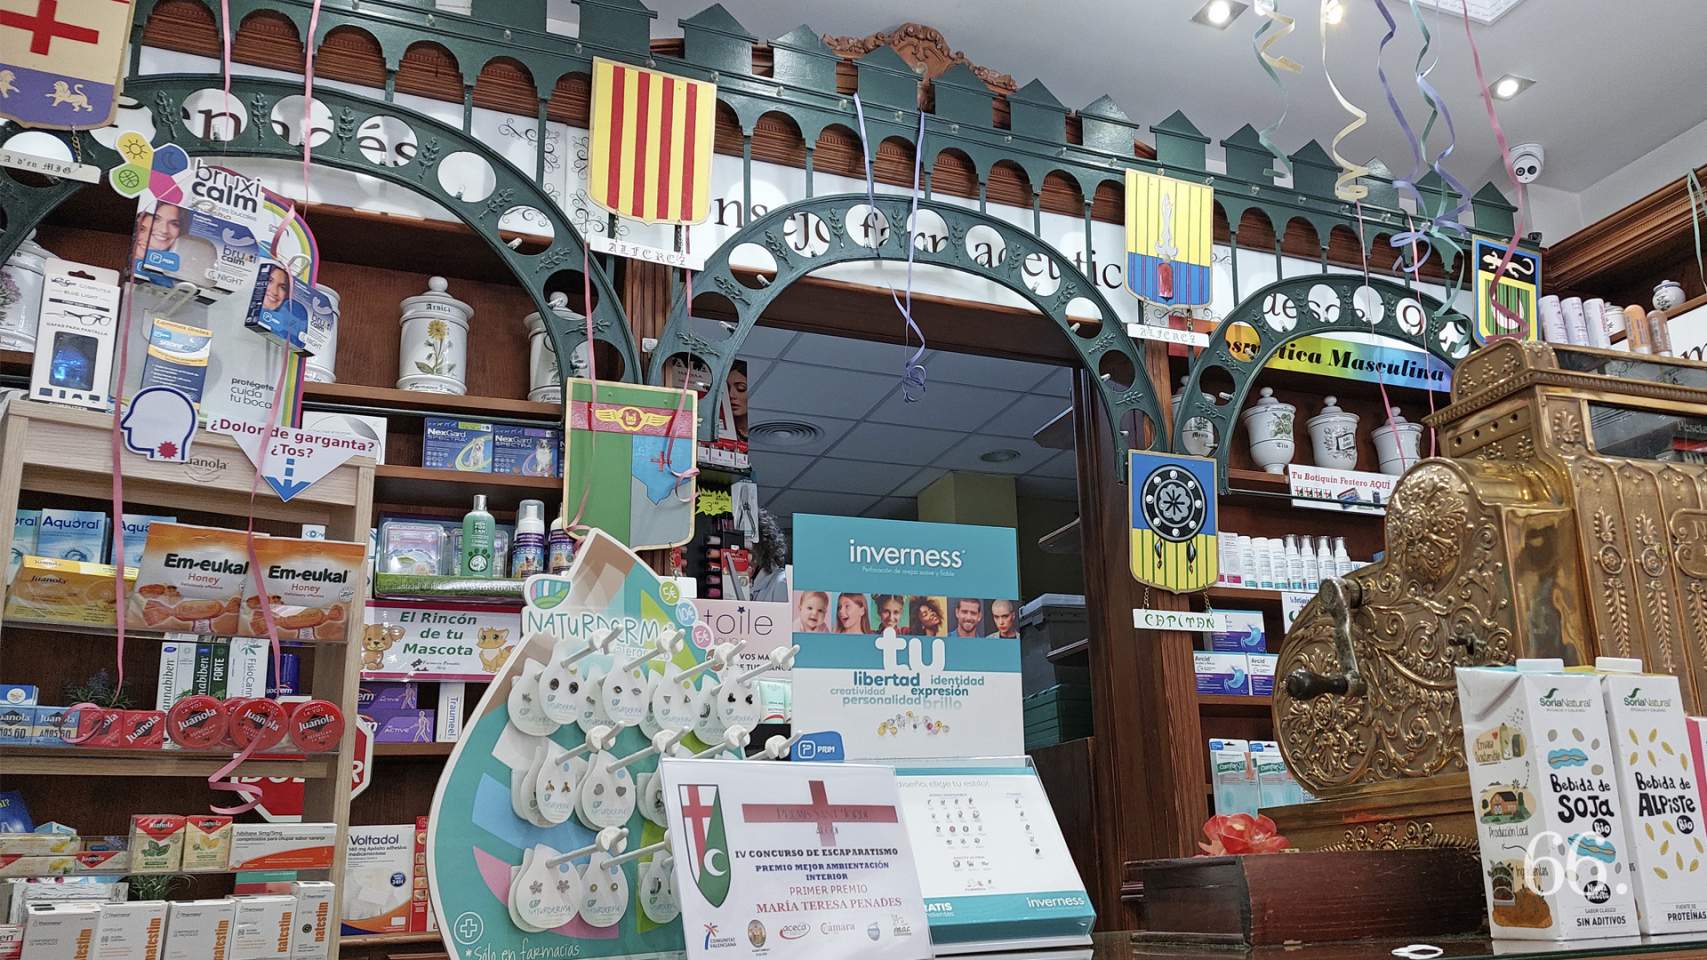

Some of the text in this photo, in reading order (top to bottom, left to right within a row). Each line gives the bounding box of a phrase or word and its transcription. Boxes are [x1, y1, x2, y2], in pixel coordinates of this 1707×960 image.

[195, 158, 262, 198] bruxi
[192, 181, 258, 213] calm
[217, 273, 245, 286] NIGHT
[1328, 350, 1444, 382] Masculina
[230, 386, 263, 399] cuida
[229, 394, 273, 410] tu boca
[270, 426, 290, 440] de
[294, 430, 375, 453] garganta?
[427, 427, 466, 438] NexGard
[270, 443, 314, 459] ¿Tos?
[185, 457, 229, 471] uanola
[43, 515, 100, 530] Aquoral
[849, 539, 963, 569] inverness
[164, 552, 250, 575] Em-eukal
[188, 572, 221, 586] Honey
[268, 565, 348, 585] Em-eukal
[291, 583, 321, 595] Honey
[400, 611, 477, 625] El Rincón
[703, 606, 774, 637] toile
[420, 628, 464, 640] de tu
[403, 643, 473, 656] Mascota
[875, 626, 946, 673] tu
[212, 657, 225, 682] FORTE
[853, 671, 985, 687] libertad identidad
[830, 684, 969, 699] creatividad expresión
[842, 694, 963, 711] personalidad brillo
[1539, 697, 1591, 708] SoriaNatural
[1624, 697, 1672, 708] SoriaNatural
[177, 708, 217, 731] Juanola
[299, 713, 335, 733] Juanola
[126, 713, 161, 743] Juanola
[1550, 773, 1611, 793] Bebida de
[1635, 772, 1691, 790] Bebida de
[1678, 817, 1693, 830] Bio
[350, 834, 399, 846] Voltadol
[735, 848, 898, 859] IV CONCURSO DE ESCAPARATISMO
[755, 861, 890, 873] PREMIO MEJOR AMBIENTACIÓN
[805, 873, 849, 881] INTERIOR
[789, 884, 868, 896] PRIMER PREMIO
[756, 897, 902, 914] MARÍA TERESA PENADES
[1026, 896, 1085, 909] inverness
[1576, 916, 1626, 927] SIN ADITIVOS
[1667, 910, 1707, 922] PROTEÍNAS
[520, 937, 580, 959] farmacias
